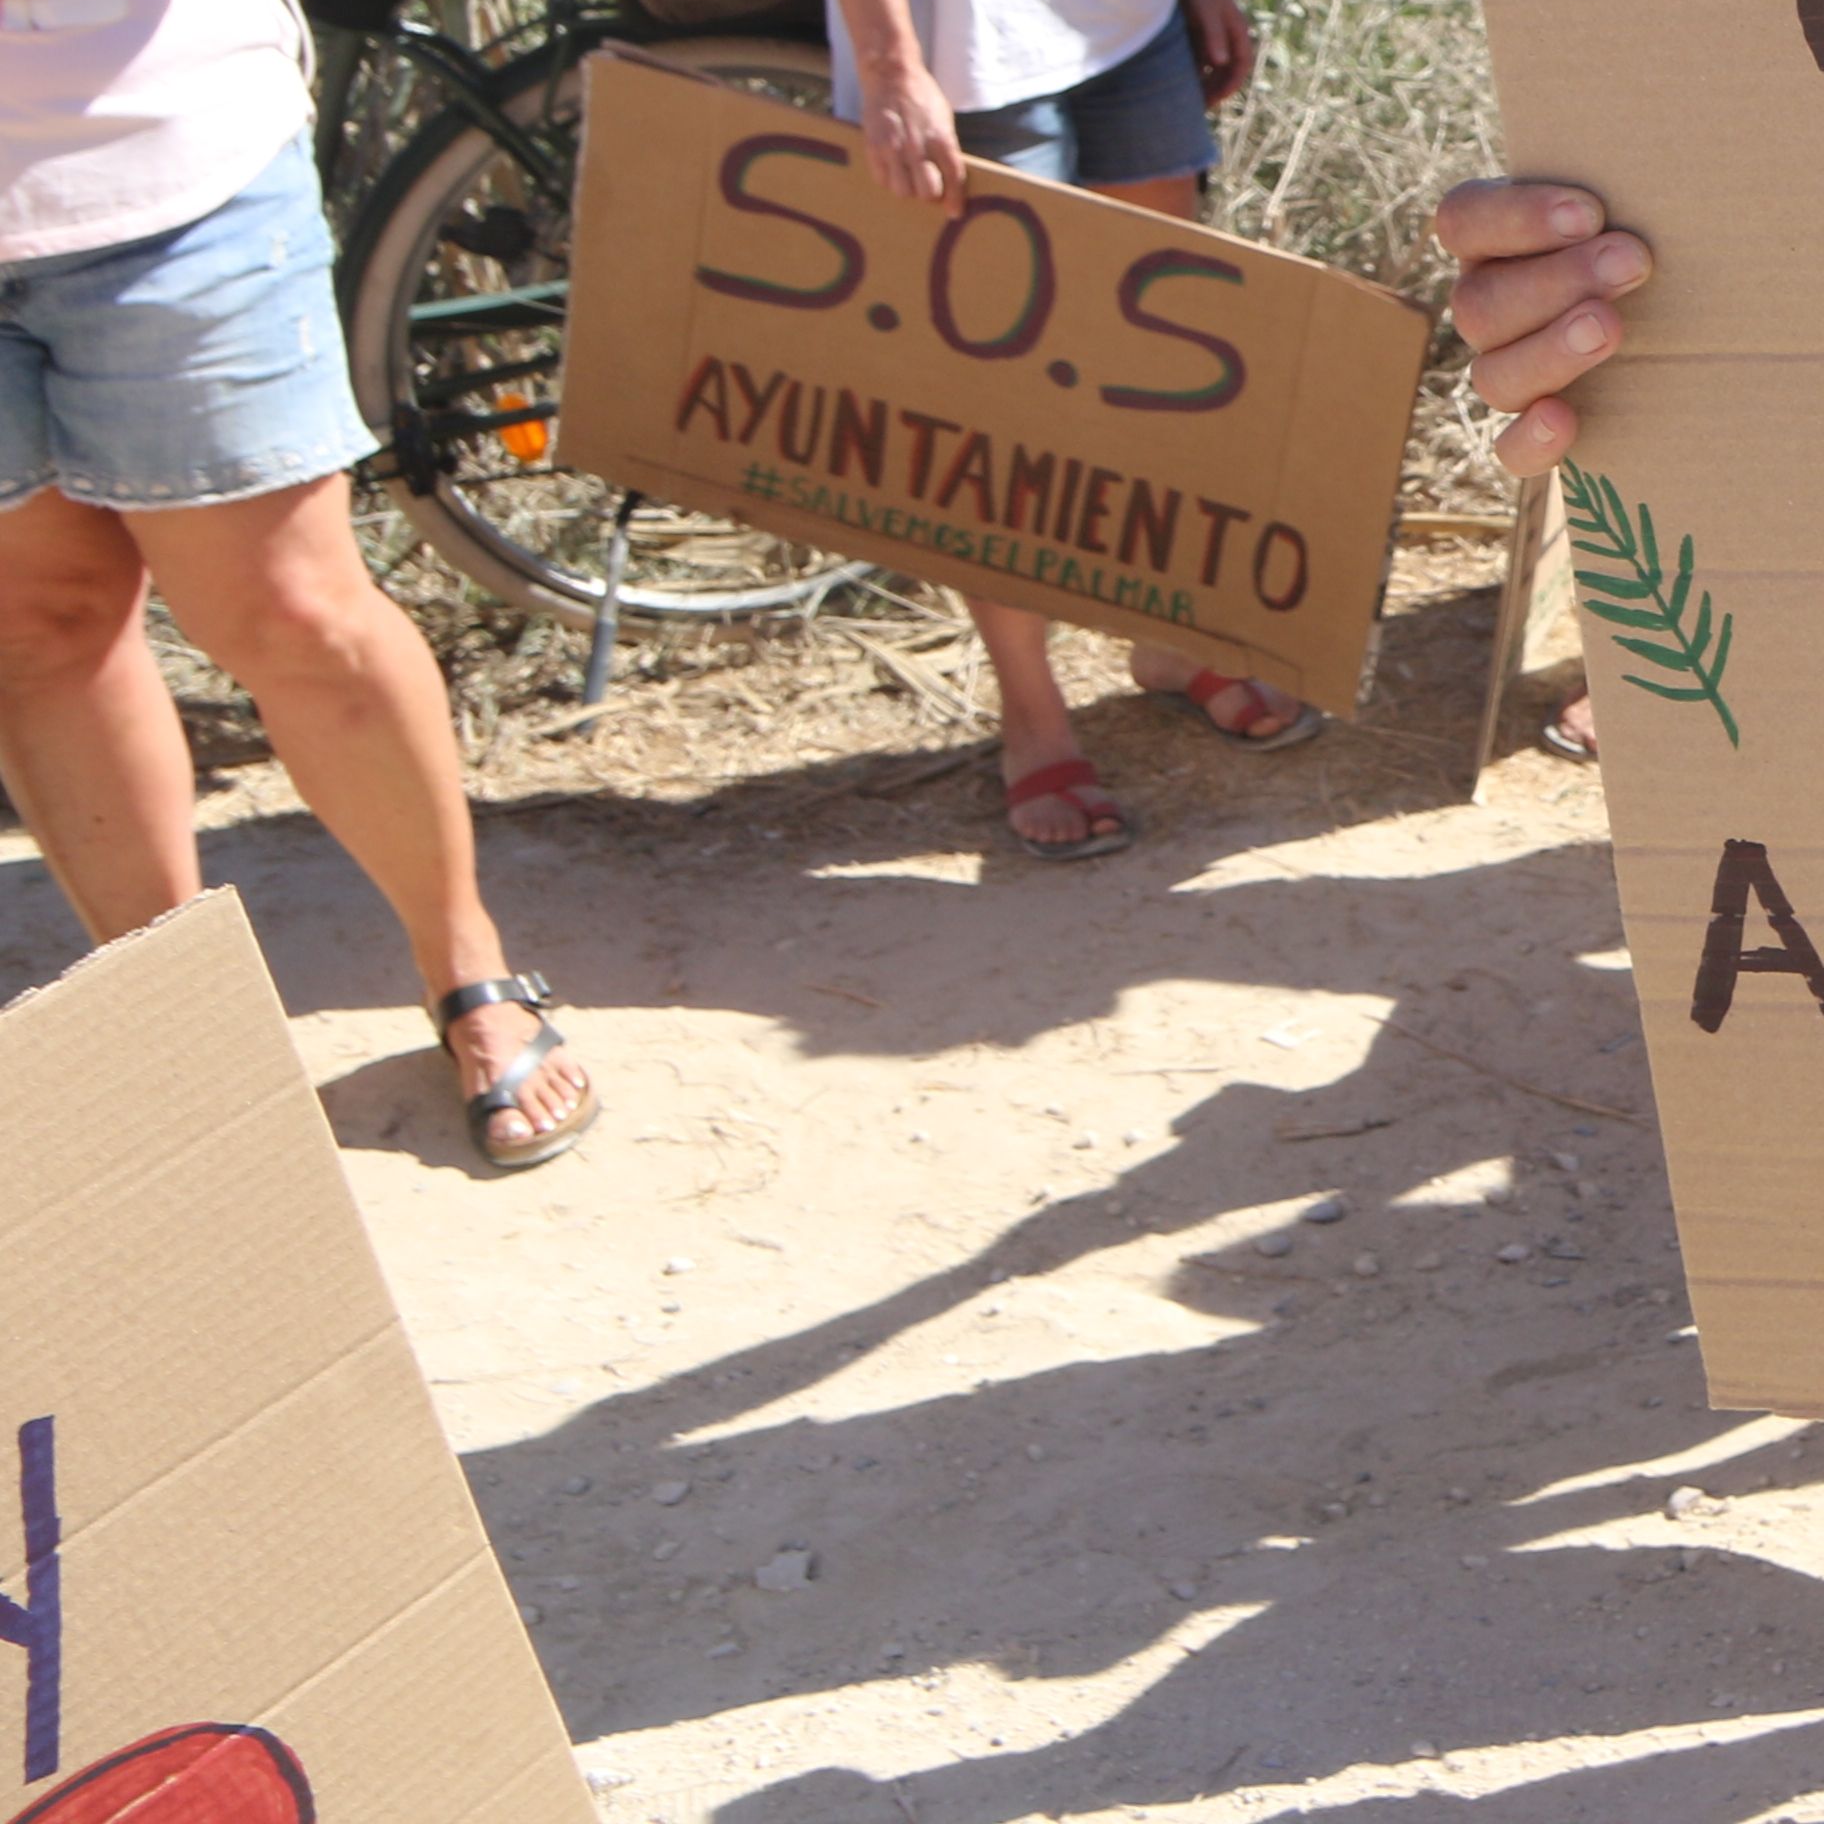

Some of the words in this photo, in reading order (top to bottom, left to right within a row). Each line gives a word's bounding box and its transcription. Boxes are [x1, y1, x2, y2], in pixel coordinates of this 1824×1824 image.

[694, 134, 1248, 412] S.O.S
[676, 355, 1309, 612] AYUNTAMIENTO
[742, 461, 1199, 626] #SALVEMOSELPALMAR
